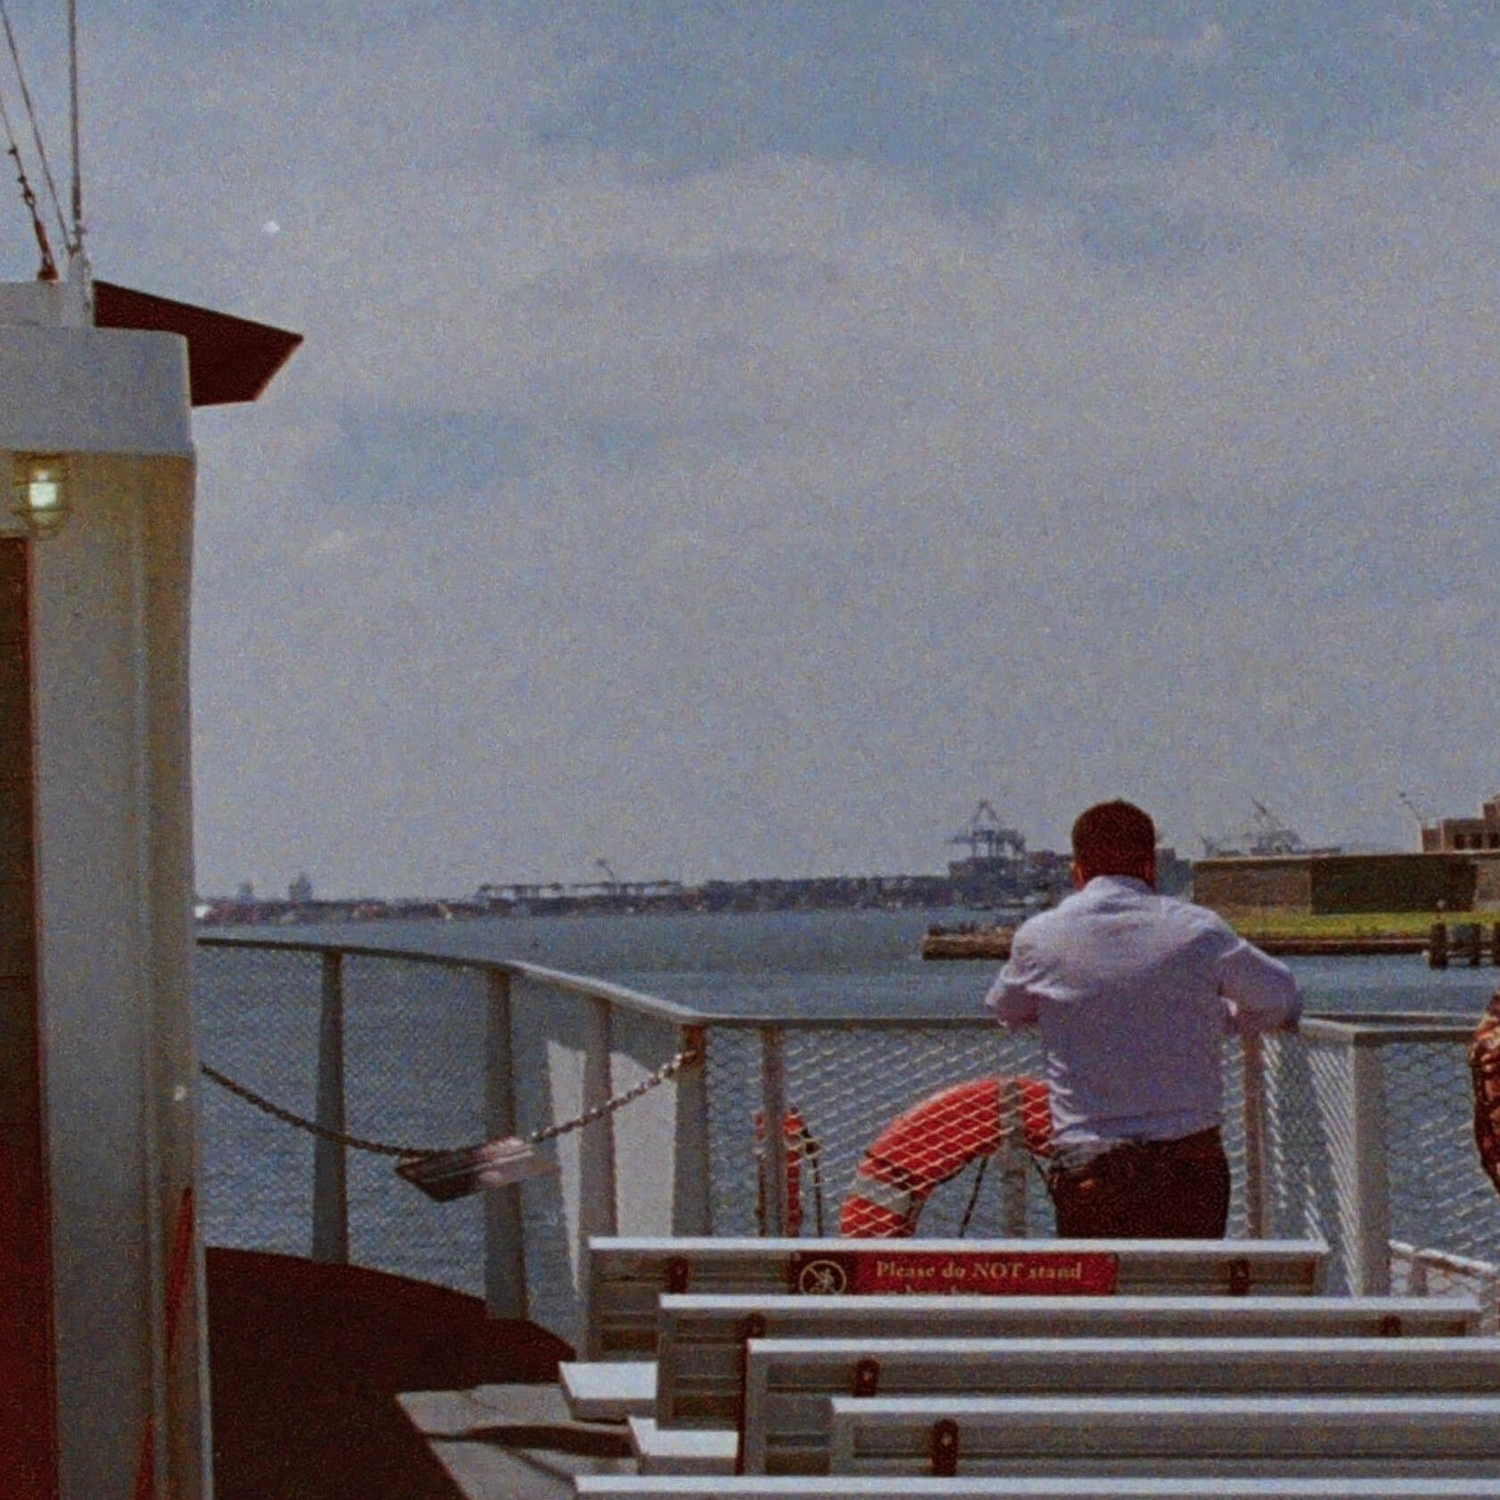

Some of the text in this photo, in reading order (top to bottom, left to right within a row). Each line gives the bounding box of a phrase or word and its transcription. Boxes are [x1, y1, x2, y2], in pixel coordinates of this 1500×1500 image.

[876, 1260, 1083, 1280] Please do NOT stand
